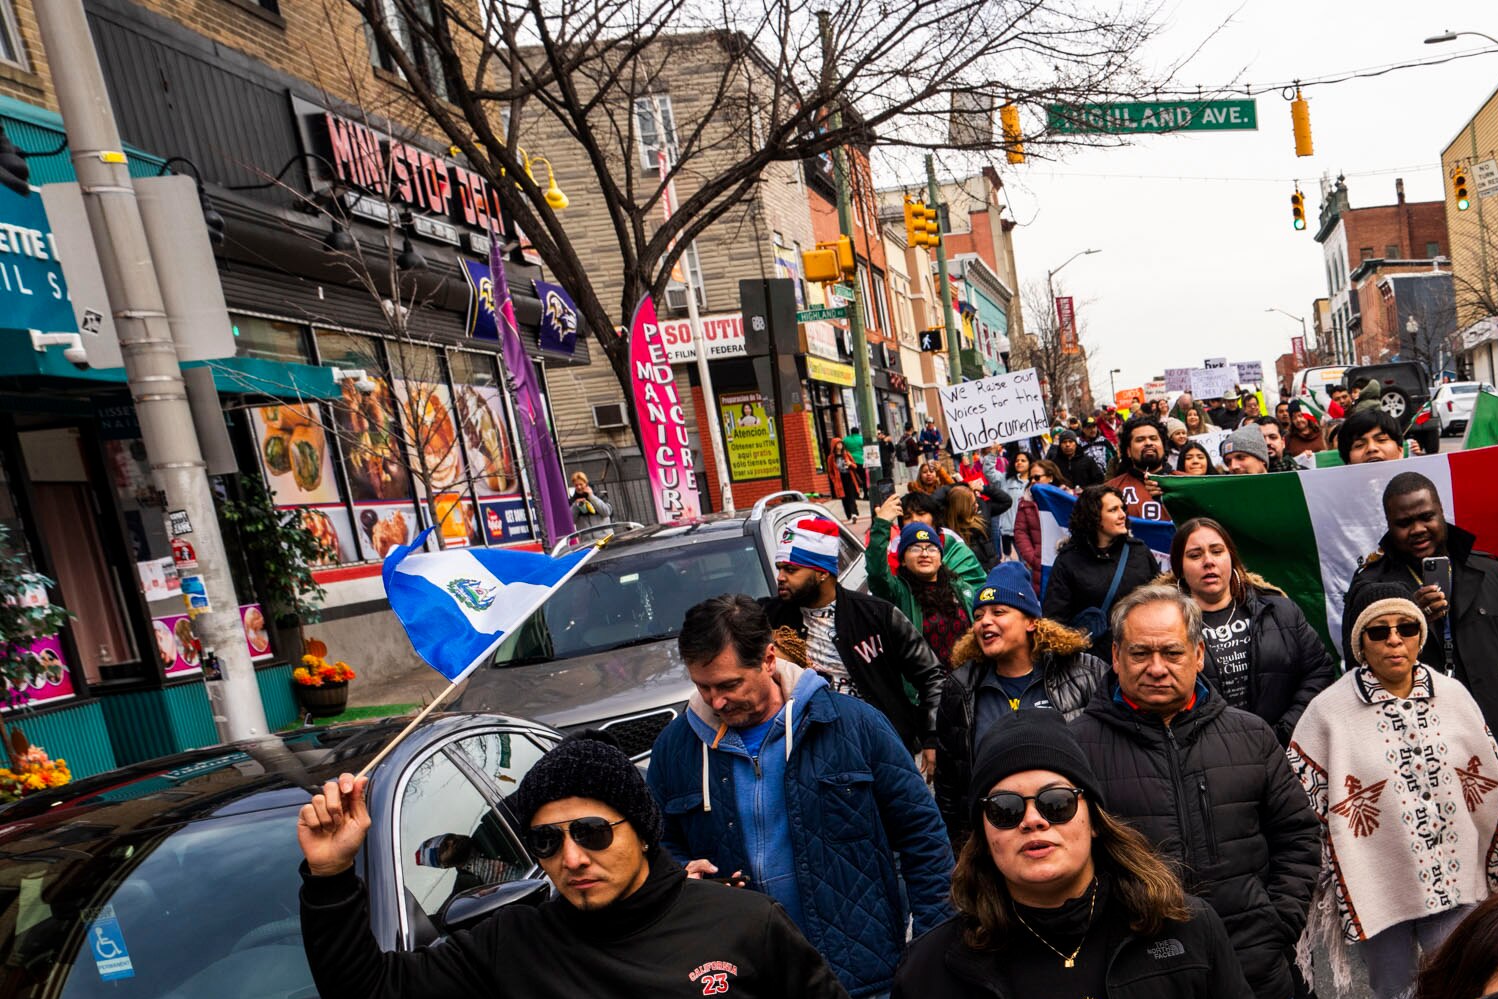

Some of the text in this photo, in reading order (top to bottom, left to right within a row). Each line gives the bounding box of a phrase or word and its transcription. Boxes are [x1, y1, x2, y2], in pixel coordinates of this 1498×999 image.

[1062, 106, 1249, 128] HIGHLAND AVE.
[1479, 171, 1495, 180] TURN
[391, 139, 452, 217] STOP
[455, 166, 506, 236] DELI
[800, 309, 836, 320] HIGHLAND
[675, 347, 697, 359] FILIN
[711, 344, 746, 354] FEDERA
[941, 387, 967, 403] We
[975, 380, 1008, 394] Raise
[643, 322, 697, 490] PEDICURE
[946, 388, 1039, 422] Voices for the
[950, 407, 1049, 451] Undocumented
[1224, 662, 1249, 674] Chin
[1154, 940, 1169, 949] THE
[688, 961, 738, 982] CALIFORNIA
[701, 973, 729, 995] 23
